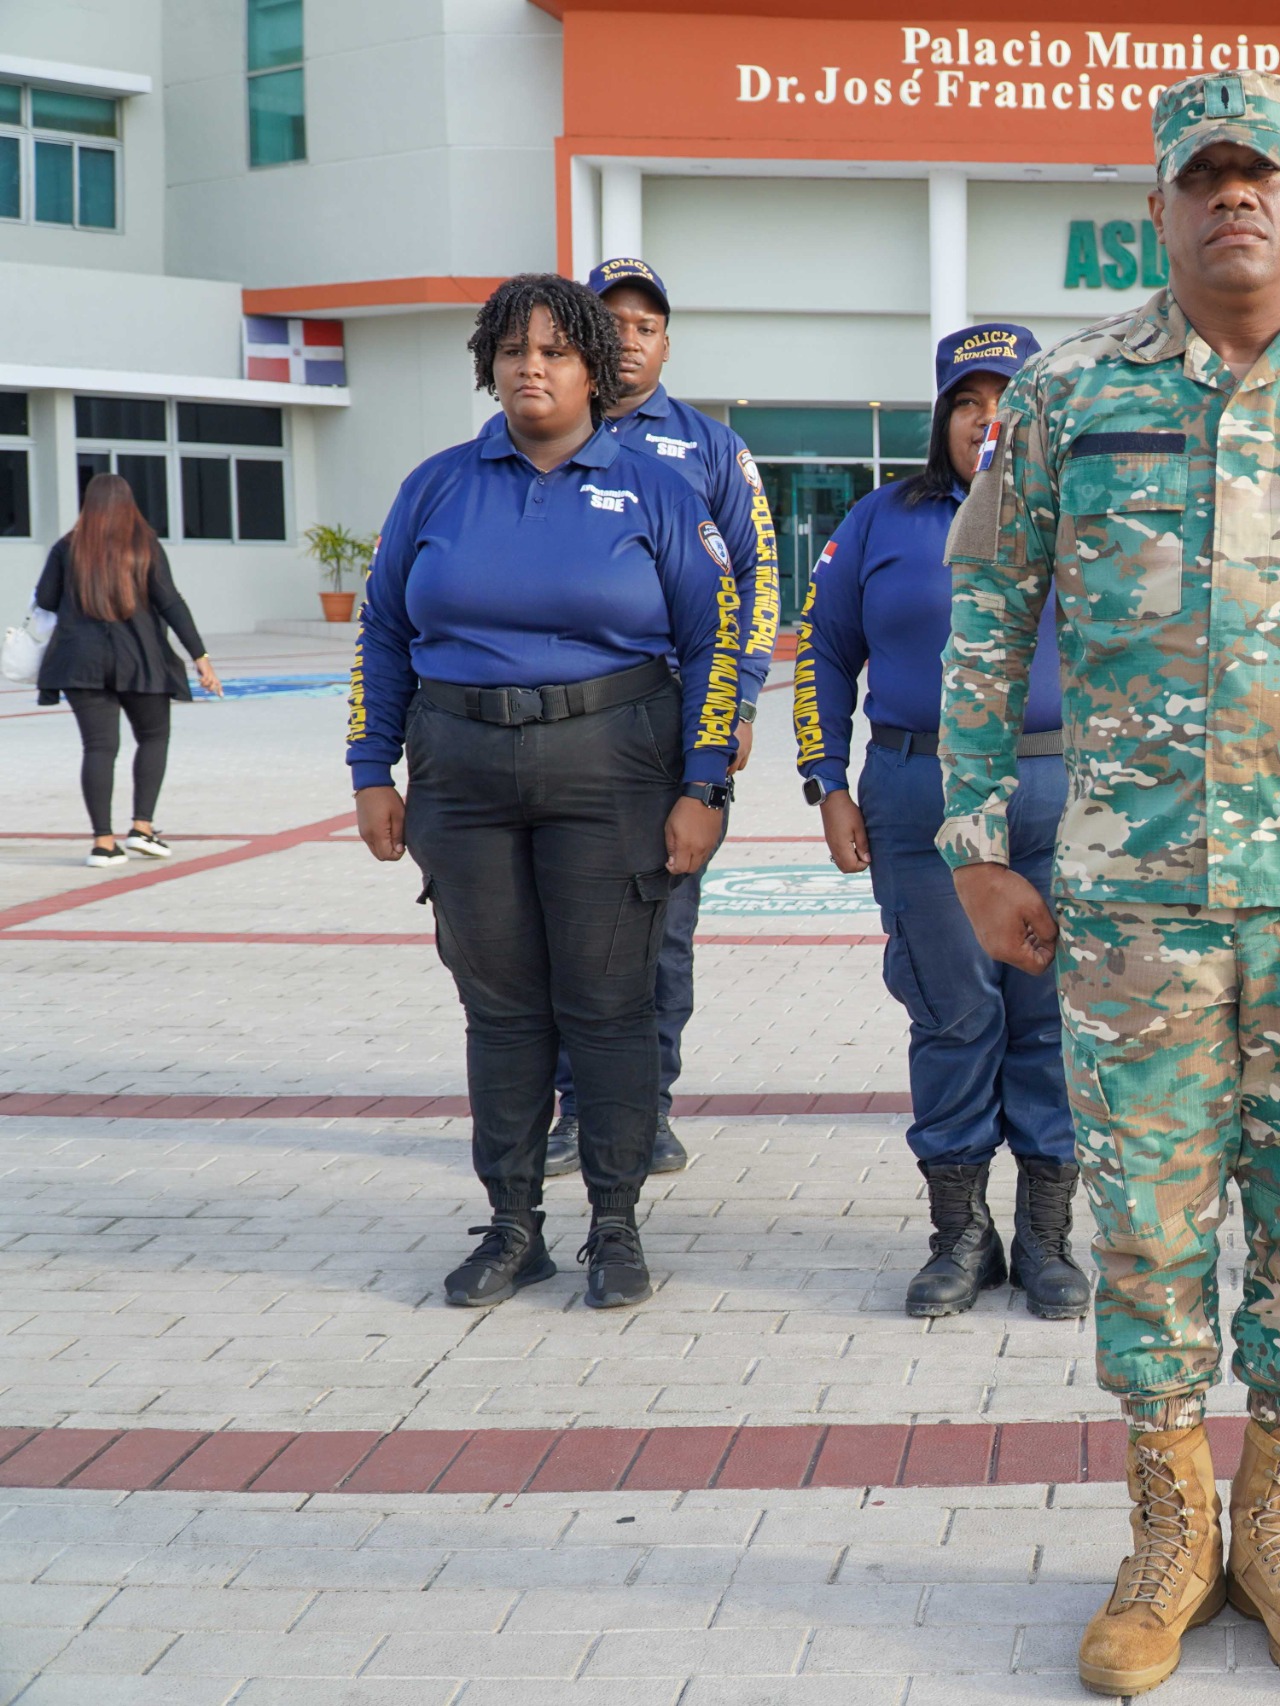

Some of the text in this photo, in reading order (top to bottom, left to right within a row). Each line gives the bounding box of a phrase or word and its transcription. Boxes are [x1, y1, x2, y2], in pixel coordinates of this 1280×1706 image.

[901, 27, 1071, 67] Palacio
[736, 64, 806, 103] Dr.
[814, 67, 924, 107] José
[953, 331, 1018, 355] POLICIA
[953, 346, 1018, 364] MUNICIPAL
[656, 442, 686, 459] SDE
[590, 494, 625, 512] SDE
[745, 495, 779, 655] POLICIA MUNICIPAL
[694, 576, 741, 749] POLICIA MUNICIPA
